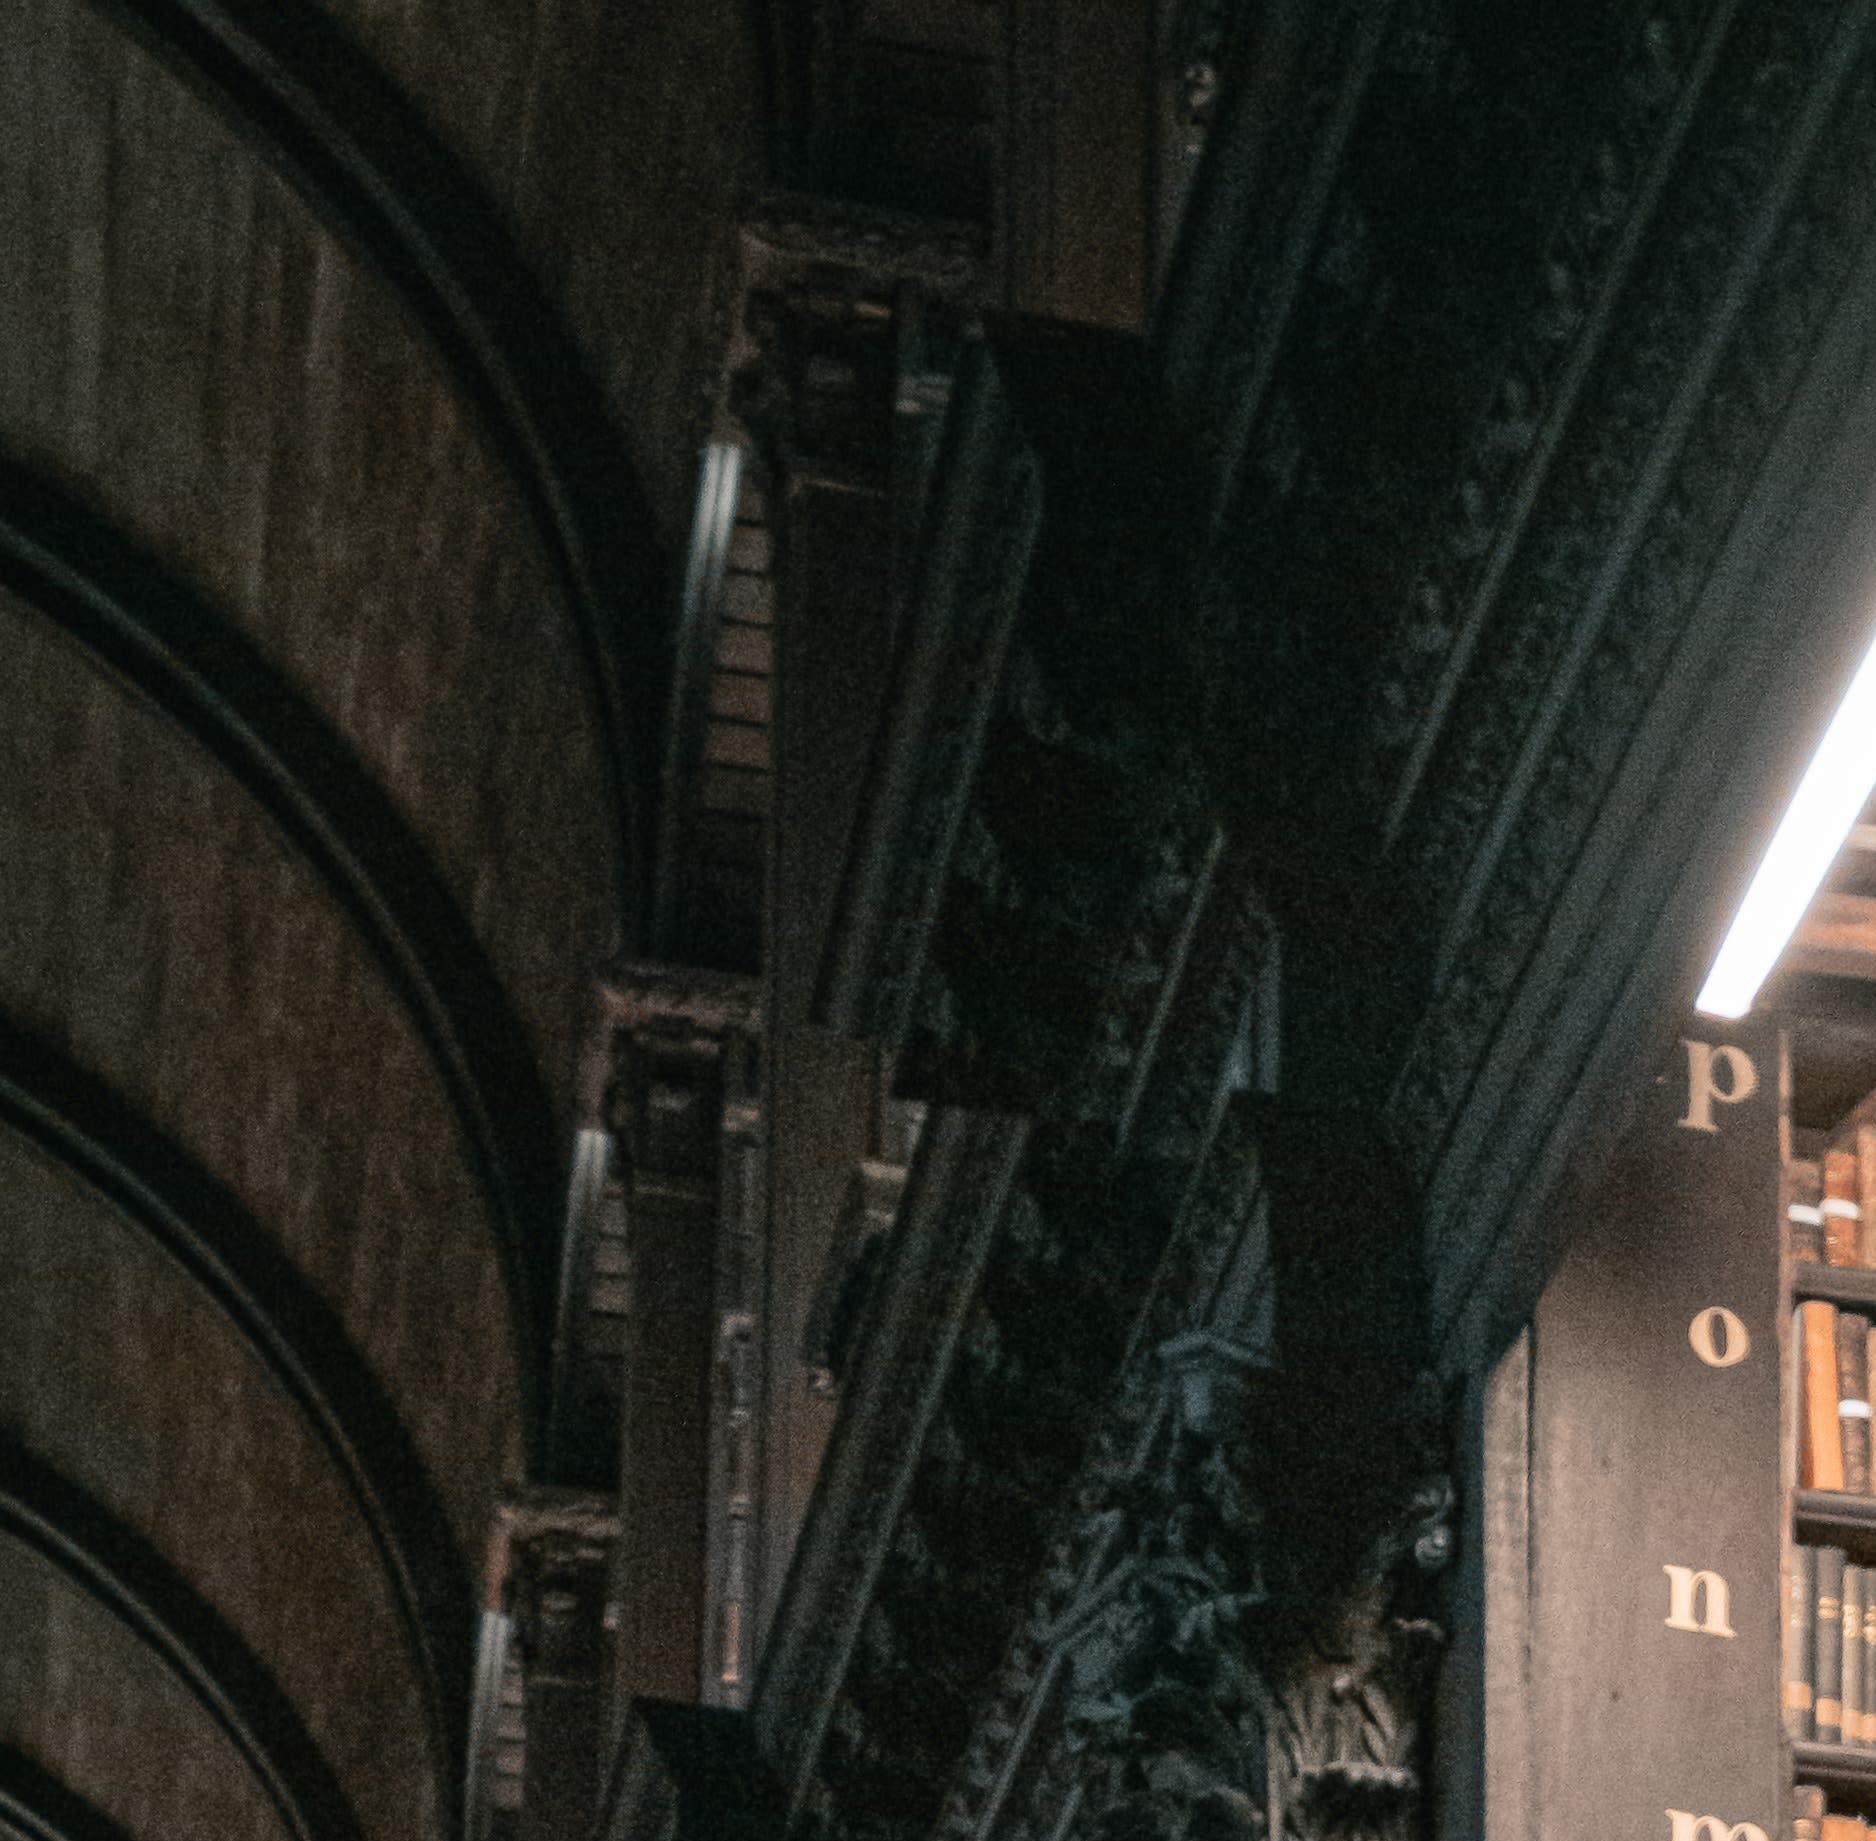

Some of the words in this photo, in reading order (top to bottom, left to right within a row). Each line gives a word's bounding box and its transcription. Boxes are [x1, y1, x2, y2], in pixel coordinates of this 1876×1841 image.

[1679, 1041, 1758, 1131] p
[1689, 1307, 1750, 1368] o
[1663, 1564, 1734, 1637] n
